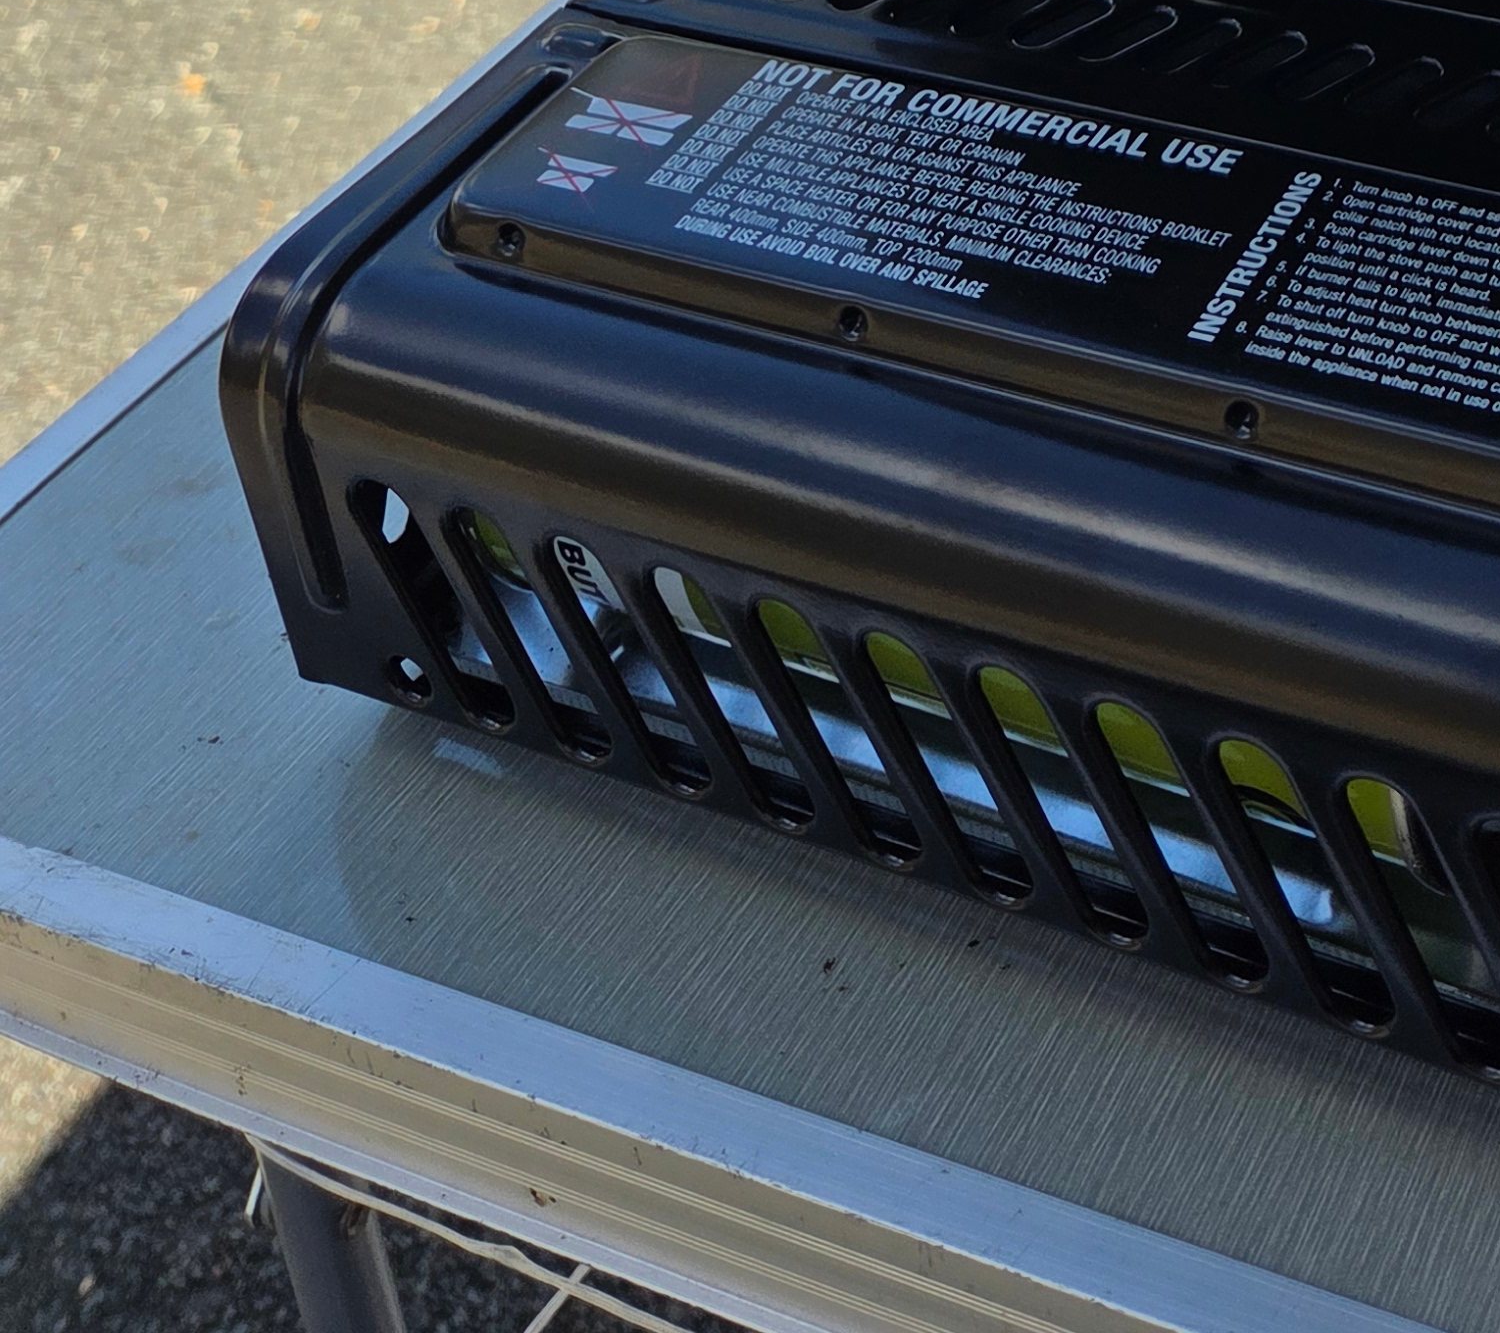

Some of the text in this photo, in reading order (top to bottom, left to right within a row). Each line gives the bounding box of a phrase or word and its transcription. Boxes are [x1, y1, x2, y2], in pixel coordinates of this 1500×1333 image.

[722, 94, 749, 110] DO
[744, 99, 778, 116] NOT
[782, 106, 842, 128] OPERATE
[837, 117, 858, 132] IN
[864, 122, 906, 143] BOAT,
[904, 130, 943, 148] TENT
[938, 137, 963, 153] OR
[961, 142, 1026, 167] CARAVAN
[737, 80, 995, 142] DO NOT OPERATE IN AN ENCLOSED AREA
[752, 59, 1244, 174] NOT FOR COMMERCIAL USE
[692, 124, 1232, 247] DO NOT OPERATE THIS APPLIANCE BEFORE READING THE INSTRUCTIONS BOOKLET
[707, 109, 1082, 197] DO NOT PLACE ARTICLES ON OR AGAINST THIS APPLIANCE
[646, 169, 1112, 284] DO NOT USE NEAR COMBUSTIBLE MATERIALS. MINIMUM CLEARANCES:
[662, 154, 689, 170] DO
[682, 158, 719, 176] NOT
[722, 167, 754, 183] USE
[760, 175, 809, 196] SPACE
[803, 184, 859, 207] HEATER
[856, 195, 881, 212] OR
[877, 200, 910, 219] FOR
[905, 206, 941, 225] ANY
[936, 212, 1006, 240] PURPOSE
[1002, 227, 1054, 251] OTHER
[1052, 237, 1095, 259] THAN
[1093, 246, 1162, 274] COOKING
[677, 138, 704, 154] DO
[699, 143, 734, 161] NOT
[737, 151, 769, 168] USE
[764, 156, 831, 181] MULTIPLE
[825, 170, 910, 199] APPLIANCES
[907, 186, 930, 203] TO
[927, 191, 969, 211] HEAT
[977, 202, 1032, 225] SINGLE
[1029, 213, 1096, 239] COOKING
[1093, 226, 1150, 250] DEVICE
[1322, 190, 1334, 202] 2.
[1342, 194, 1376, 210] Open
[1377, 204, 1435, 223] cartridge
[1437, 216, 1474, 231] cover
[1332, 210, 1369, 224] collar
[1370, 218, 1407, 233] notch
[1409, 226, 1437, 239] with
[1439, 233, 1464, 245] red
[1333, 178, 1342, 188] 1.
[1352, 181, 1380, 195] Turn
[1381, 188, 1413, 203] knob
[1415, 195, 1429, 206] to
[1432, 198, 1459, 211] OFF
[1459, 205, 1486, 218] and
[674, 215, 989, 299] DURING USE AVOID BOIL OVER AND SPILLAGE
[690, 198, 963, 272] REAR 400mm, SIDE 400mm, TOP 1200mm
[1187, 171, 1322, 342] INSTRUCTIONS
[1266, 275, 1277, 288] 6.
[1287, 279, 1302, 293] To
[1303, 285, 1346, 302] adjust
[1346, 293, 1378, 310] heat
[1379, 300, 1407, 316] turn
[1408, 307, 1443, 325] knob
[1303, 252, 1356, 270] position
[1357, 263, 1389, 277] until
[1401, 273, 1433, 288] click
[1434, 278, 1448, 291] is
[1449, 282, 1491, 301] heard.
[1265, 311, 1351, 338] extinguished
[1350, 328, 1395, 349] before
[1394, 341, 1472, 370] performing
